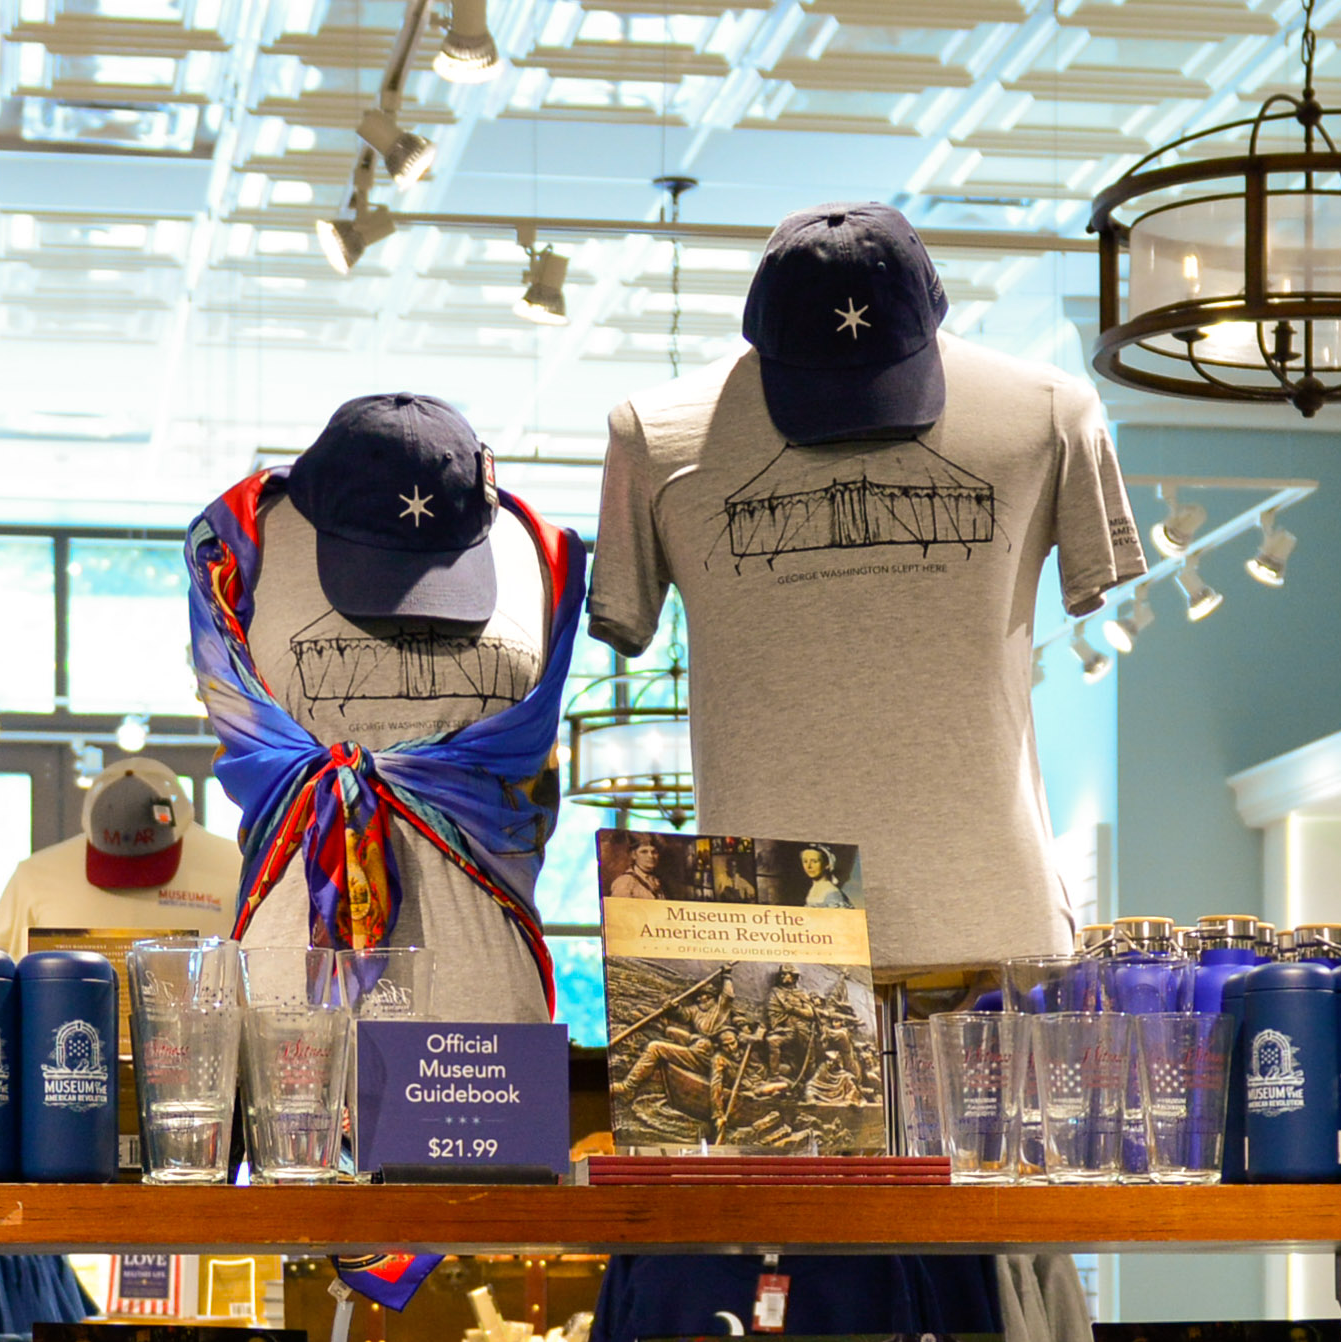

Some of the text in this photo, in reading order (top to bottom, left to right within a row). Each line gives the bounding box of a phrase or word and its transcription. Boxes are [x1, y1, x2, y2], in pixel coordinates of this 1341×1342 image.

[777, 563, 948, 585] GEORGE WASHINGTON SLEPT HERE
[349, 721, 385, 733] GEORGE
[388, 718, 451, 731] WASHINGTON
[159, 889, 204, 901] MUSEUM
[666, 906, 804, 926] Museum of the
[640, 923, 833, 946] American Revolution
[677, 945, 798, 957] OFFICIAL GUIDEBOOK
[427, 1033, 498, 1054] Official
[419, 1059, 506, 1079] Museum
[44, 1080, 94, 1094] MUSEUM
[405, 1083, 520, 1104] Guidebook
[428, 1137, 498, 1159] $21.99
[124, 1254, 167, 1266] LOVE
